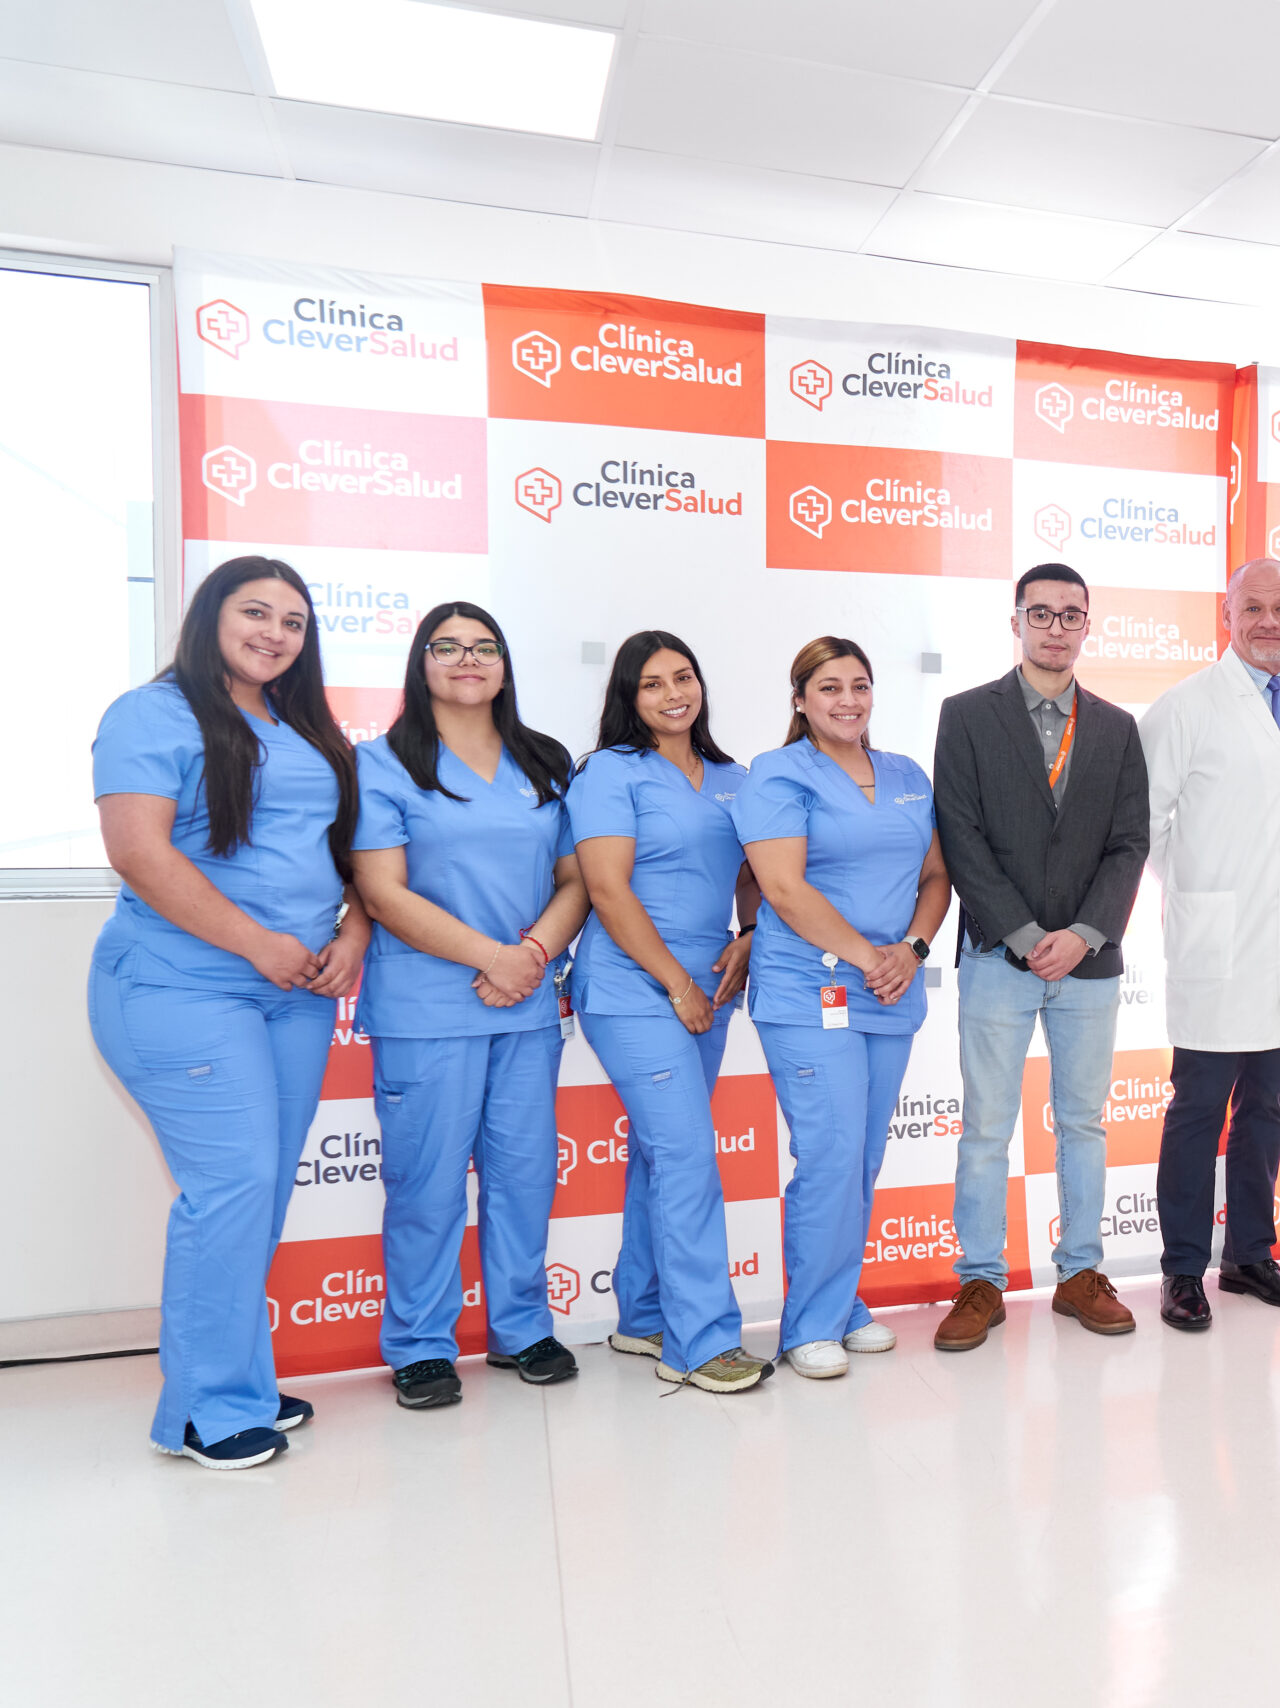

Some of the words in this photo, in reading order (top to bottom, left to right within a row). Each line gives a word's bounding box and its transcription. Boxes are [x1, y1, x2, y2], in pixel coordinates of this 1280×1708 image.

[294, 298, 402, 330] Clínica
[262, 318, 458, 360] CleverSalud
[599, 324, 694, 356] Clínica
[570, 346, 742, 386] CleverSalud
[867, 352, 950, 378] Clínica
[842, 374, 992, 406] CleverSalud
[1104, 380, 1182, 406] Clínica
[1082, 398, 1219, 430] CleverSalud
[299, 440, 408, 470] Clínica
[267, 464, 461, 498] CleverSalud
[600, 461, 695, 488] Clínica
[572, 484, 742, 515] CleverSalud
[866, 478, 950, 504] Clínica
[840, 500, 992, 530] CleverSalud
[1102, 498, 1179, 522] Clínica
[1080, 518, 1216, 545] CleverSalud
[306, 582, 409, 609] Clínica
[1102, 616, 1180, 640] Clínica
[1081, 635, 1218, 662] CleverSalud
[1110, 1076, 1176, 1100] Clínic
[895, 1094, 960, 1118] línica
[320, 1132, 380, 1158] Clín
[1116, 1192, 1158, 1214] Clín
[322, 1269, 383, 1296] Clín
